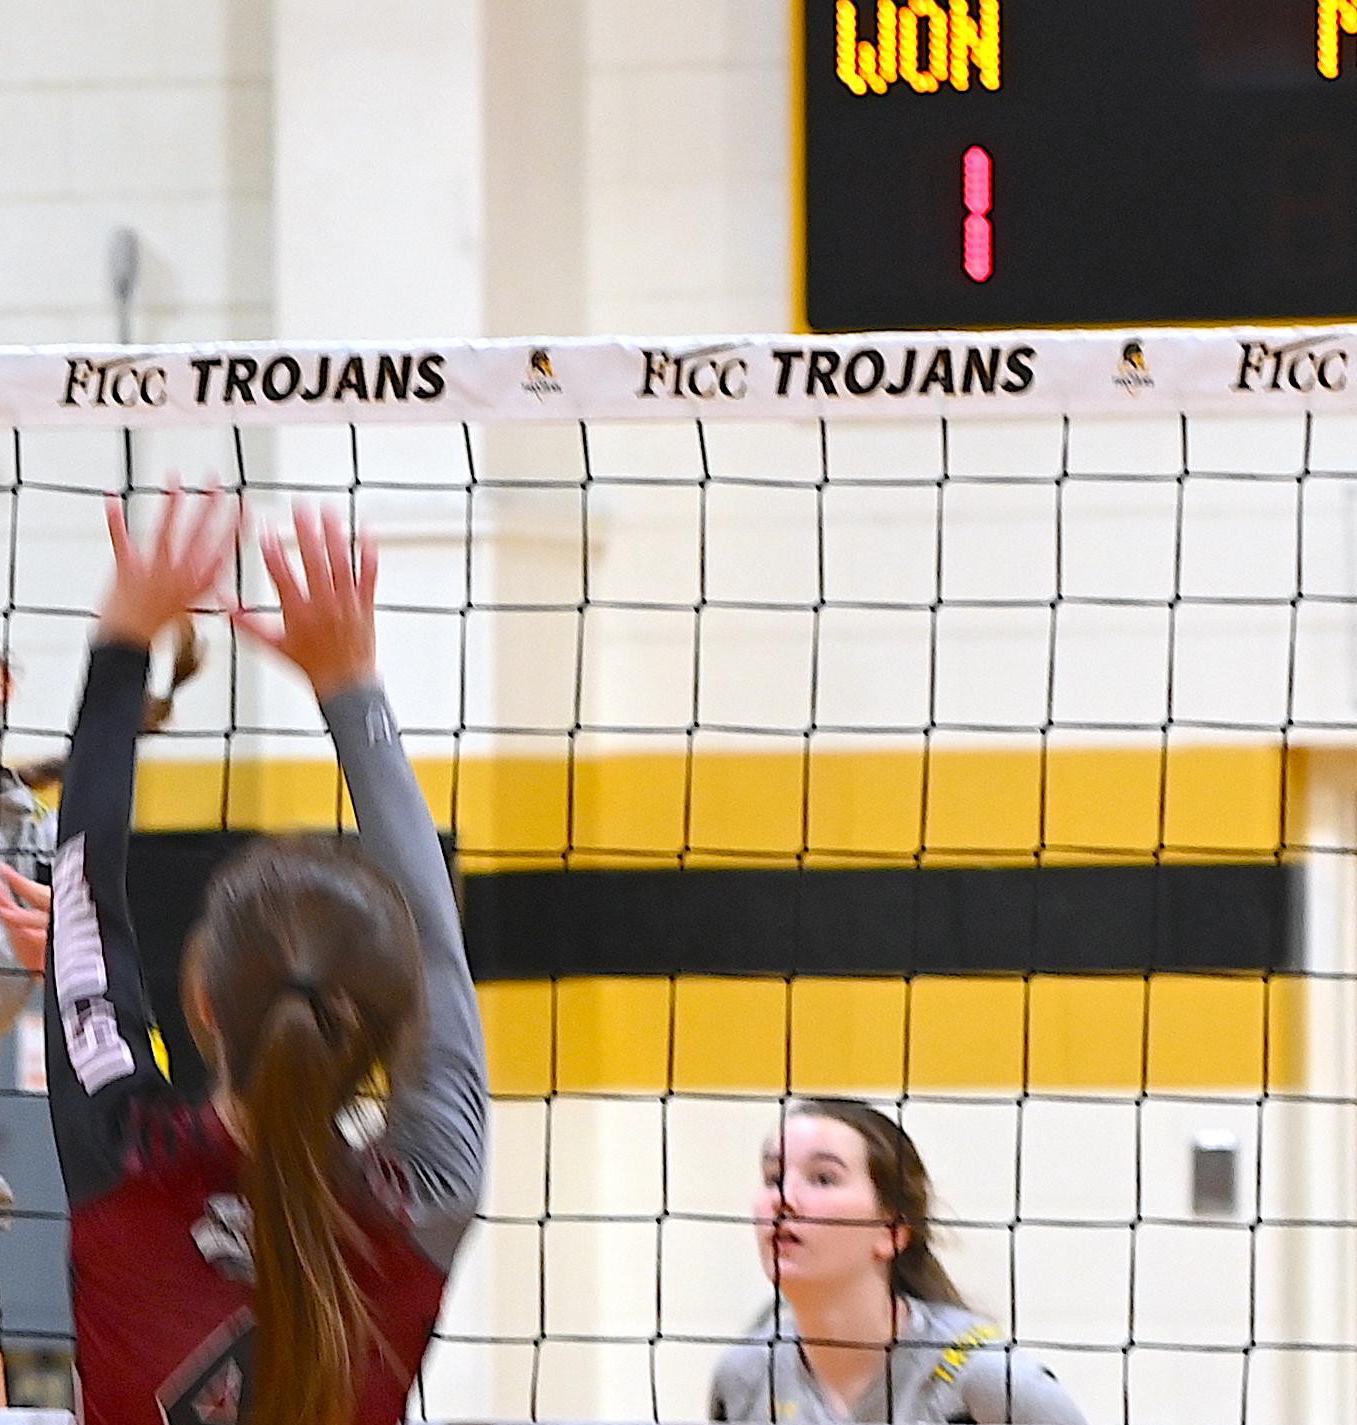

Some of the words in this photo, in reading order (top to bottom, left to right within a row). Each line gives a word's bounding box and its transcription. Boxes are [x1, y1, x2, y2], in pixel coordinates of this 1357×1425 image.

[834, 0, 1002, 95] WON
[963, 144, 993, 283] 1
[189, 353, 448, 406] TROJANS
[771, 344, 1038, 398] TROJANS
